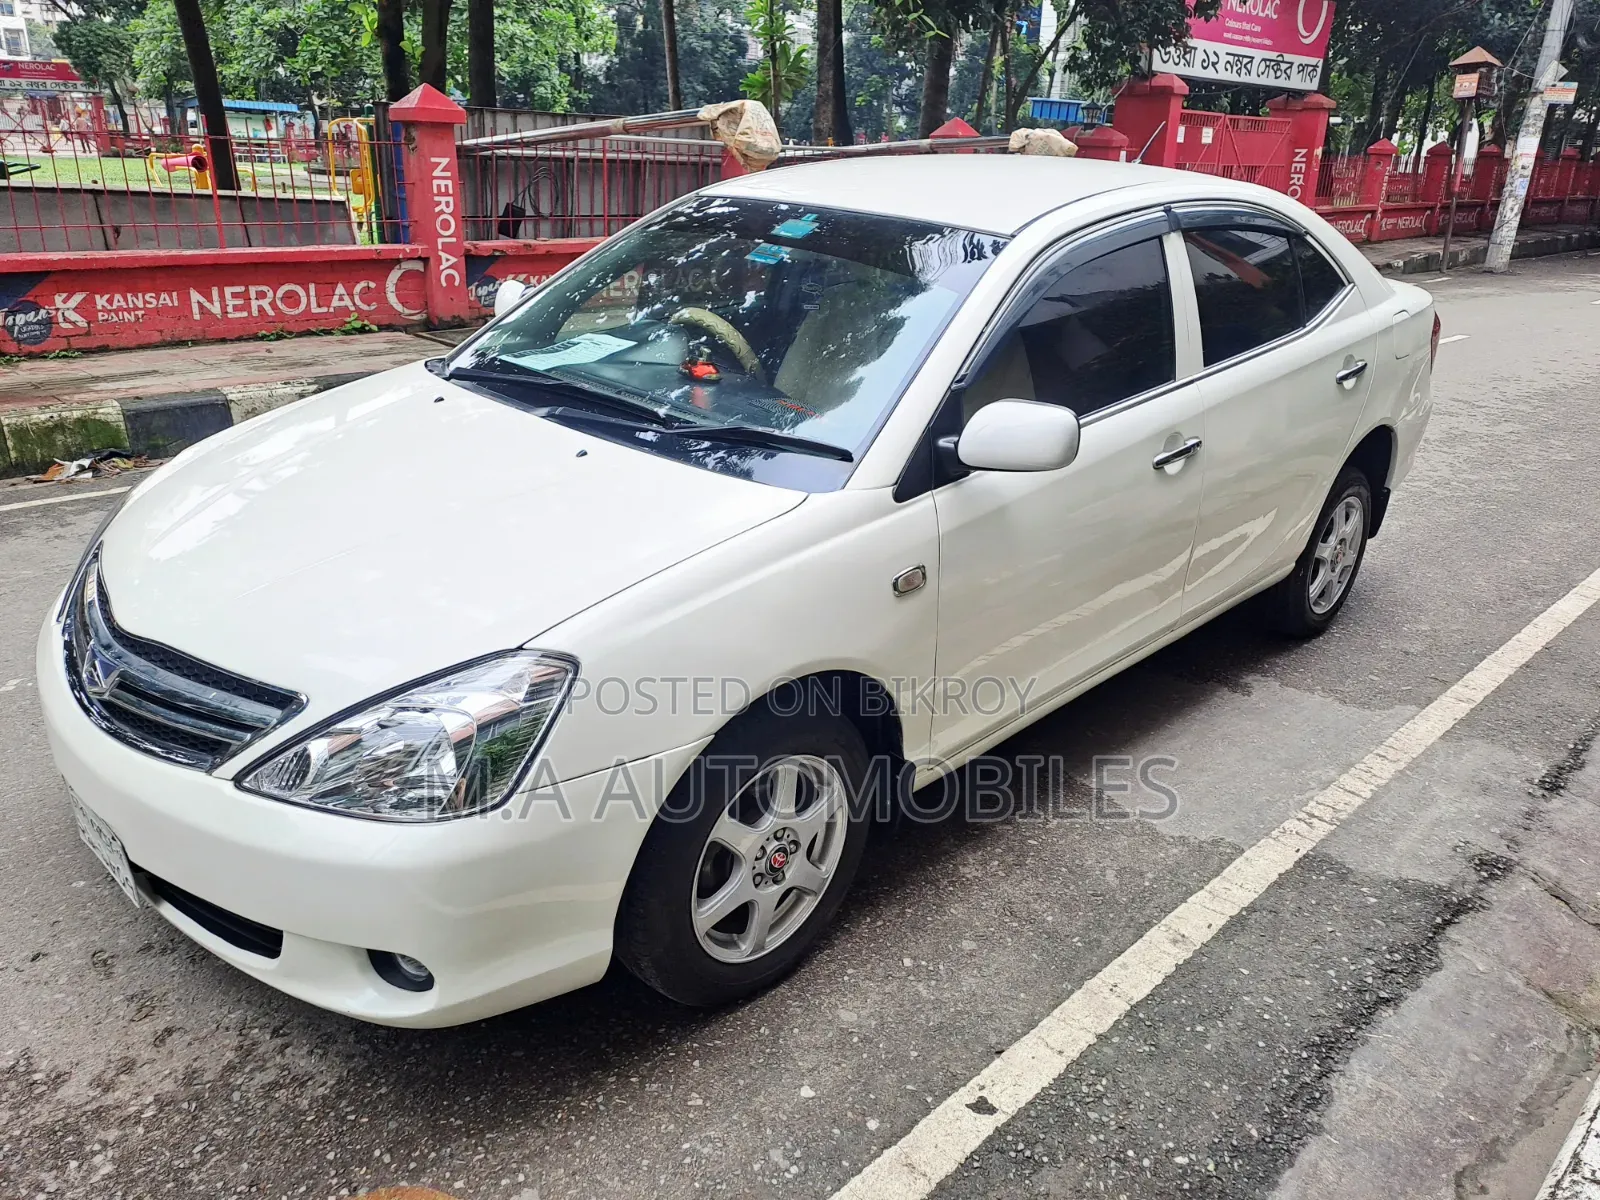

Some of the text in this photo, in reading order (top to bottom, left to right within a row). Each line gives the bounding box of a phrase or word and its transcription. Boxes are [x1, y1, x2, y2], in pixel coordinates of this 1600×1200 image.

[18, 62, 57, 71] NEROLAC
[1201, 48, 1220, 74] ১২
[1224, 52, 1256, 78] নম্বর
[1257, 54, 1295, 81] সেক্টর
[1297, 59, 1321, 83] পার্ক
[430, 157, 460, 287] NEROLAC
[1397, 215, 1424, 229] NEROLAC
[95, 291, 179, 310] KANSAI
[189, 281, 378, 320] NEROLAC
[98, 310, 146, 324] PAINT
